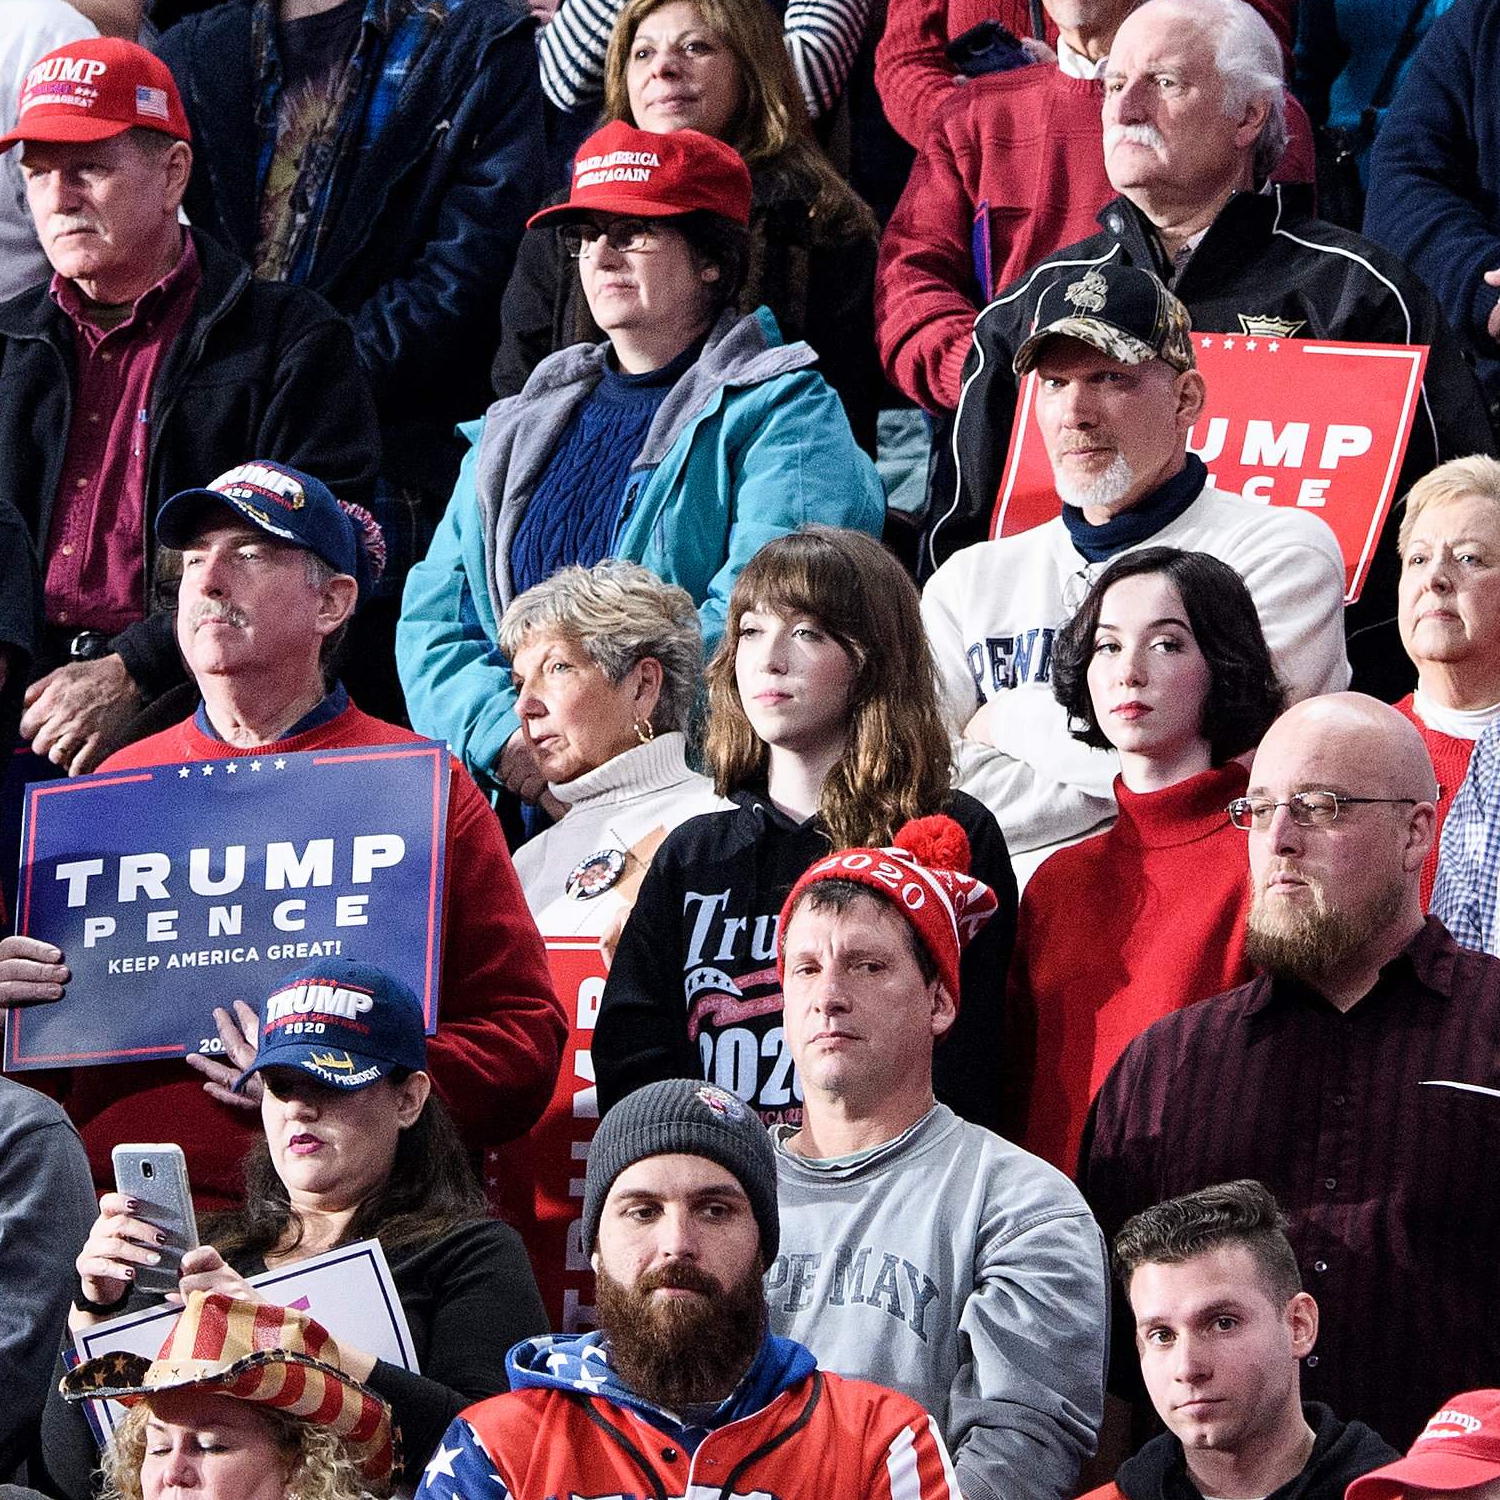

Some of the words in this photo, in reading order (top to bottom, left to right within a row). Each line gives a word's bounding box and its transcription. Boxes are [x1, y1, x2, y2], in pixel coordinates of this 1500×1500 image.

[26, 56, 107, 92] TRUMP
[599, 150, 660, 168] AMERICA
[607, 168, 651, 182] AGAIN
[1188, 417, 1373, 468] UMP
[54, 835, 408, 908] TRUMP
[810, 852, 926, 909] 2020
[82, 895, 371, 948] PENCE
[682, 888, 780, 971] Tru
[107, 955, 161, 976] KEEP
[165, 946, 259, 970] AMERICA
[265, 939, 342, 961] GREAT!
[266, 985, 374, 1024] TRUMP
[199, 1037, 228, 1053] 20
[284, 1022, 326, 1035] 2020
[333, 1064, 383, 1087] PRESIDENT
[698, 1027, 804, 1107] 02
[765, 1253, 821, 1314] PE
[828, 1246, 940, 1344] MAY
[1429, 1409, 1482, 1435] ump
